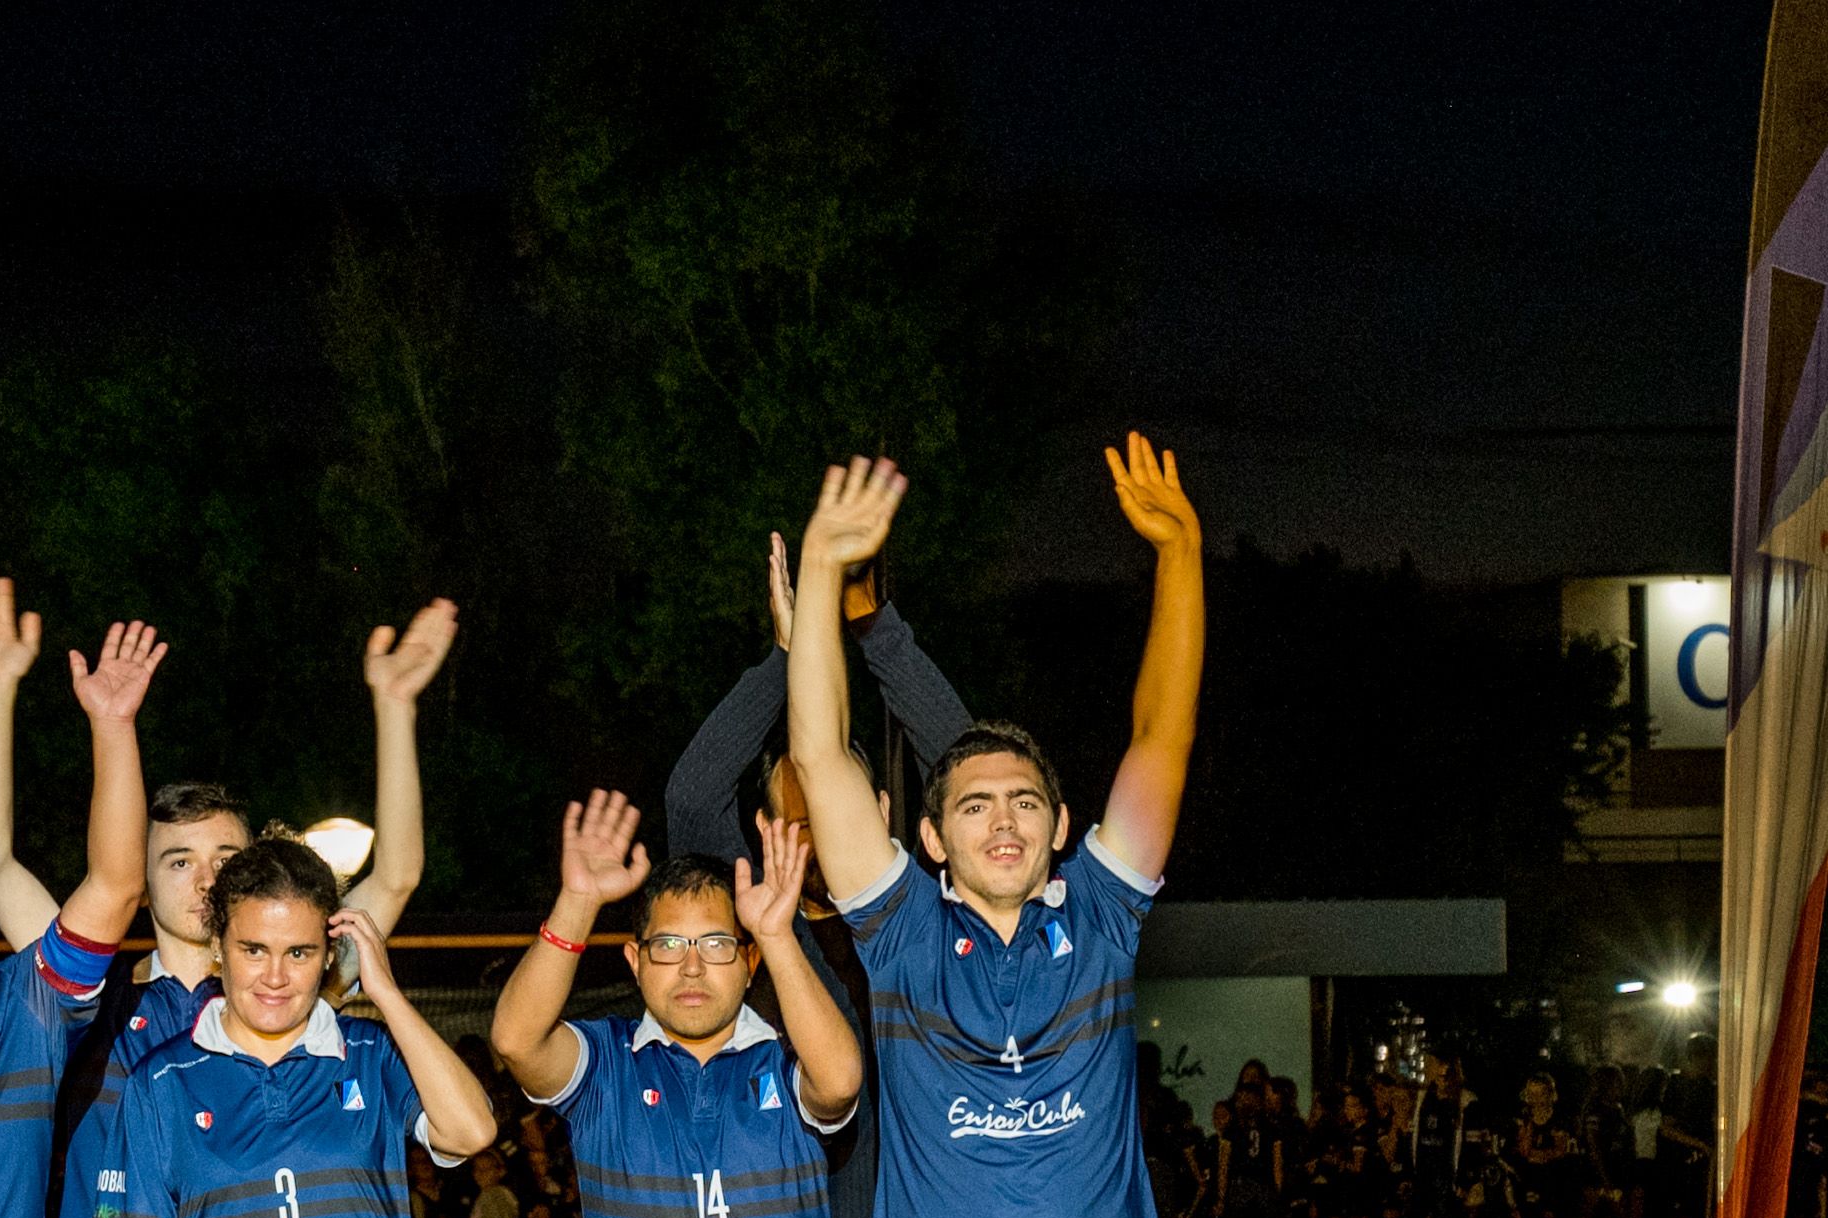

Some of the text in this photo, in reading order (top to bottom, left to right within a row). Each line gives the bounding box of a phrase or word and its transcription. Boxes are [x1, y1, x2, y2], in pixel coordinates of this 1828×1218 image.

[1000, 1035, 1025, 1074] 4
[948, 1091, 1086, 1134] Enjoy Cuba
